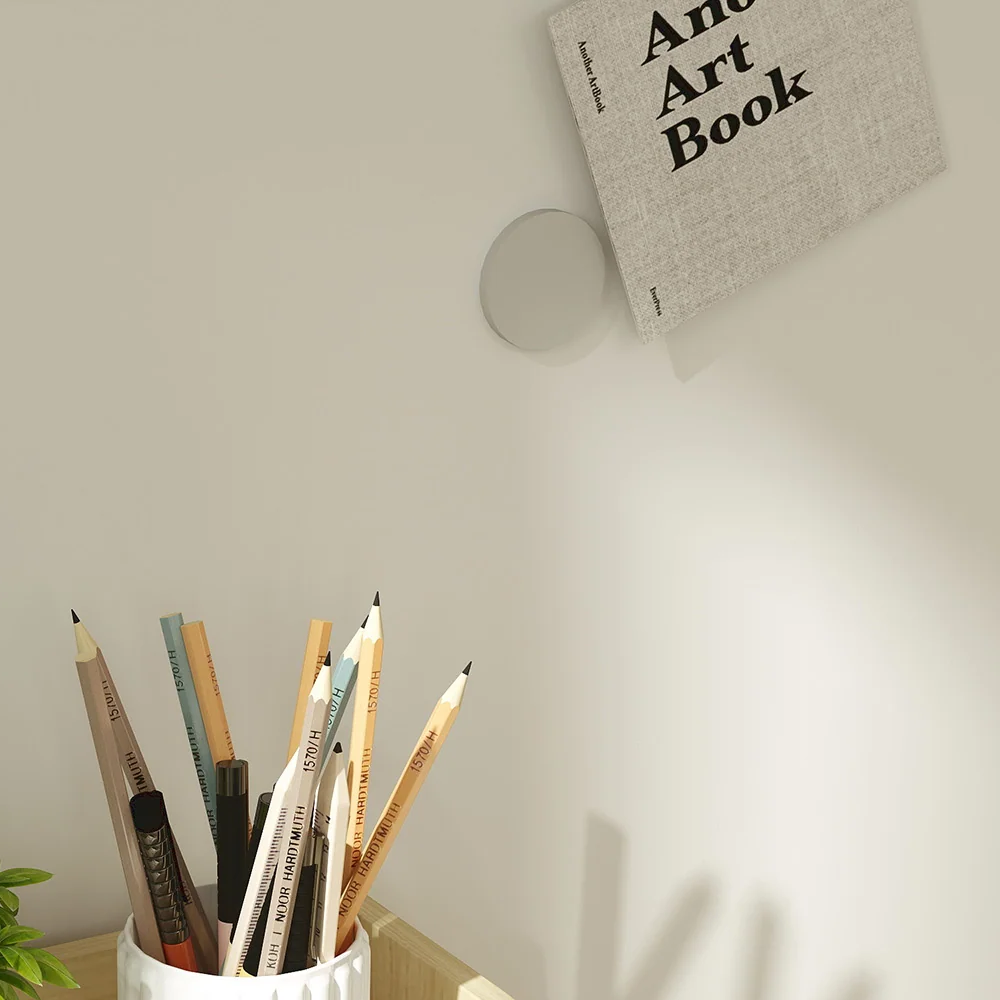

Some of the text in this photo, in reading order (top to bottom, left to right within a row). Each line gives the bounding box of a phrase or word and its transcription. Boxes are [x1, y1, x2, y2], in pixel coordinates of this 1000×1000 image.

[577, 41, 593, 76] Another
[656, 33, 755, 120] Art
[660, 66, 814, 172] Book
[167, 650, 185, 692] 1570/H
[368, 670, 381, 713] 1570/H
[303, 730, 322, 772] 1570/H
[410, 730, 438, 773] 1570/H
[351, 748, 371, 869] NOOR HARDTMUTH
[282, 806, 306, 881] HARDTMUTH
[338, 803, 401, 917] NOOR HARDTMUTH
[274, 886, 292, 923] NOOR
[266, 943, 280, 969] KOH
